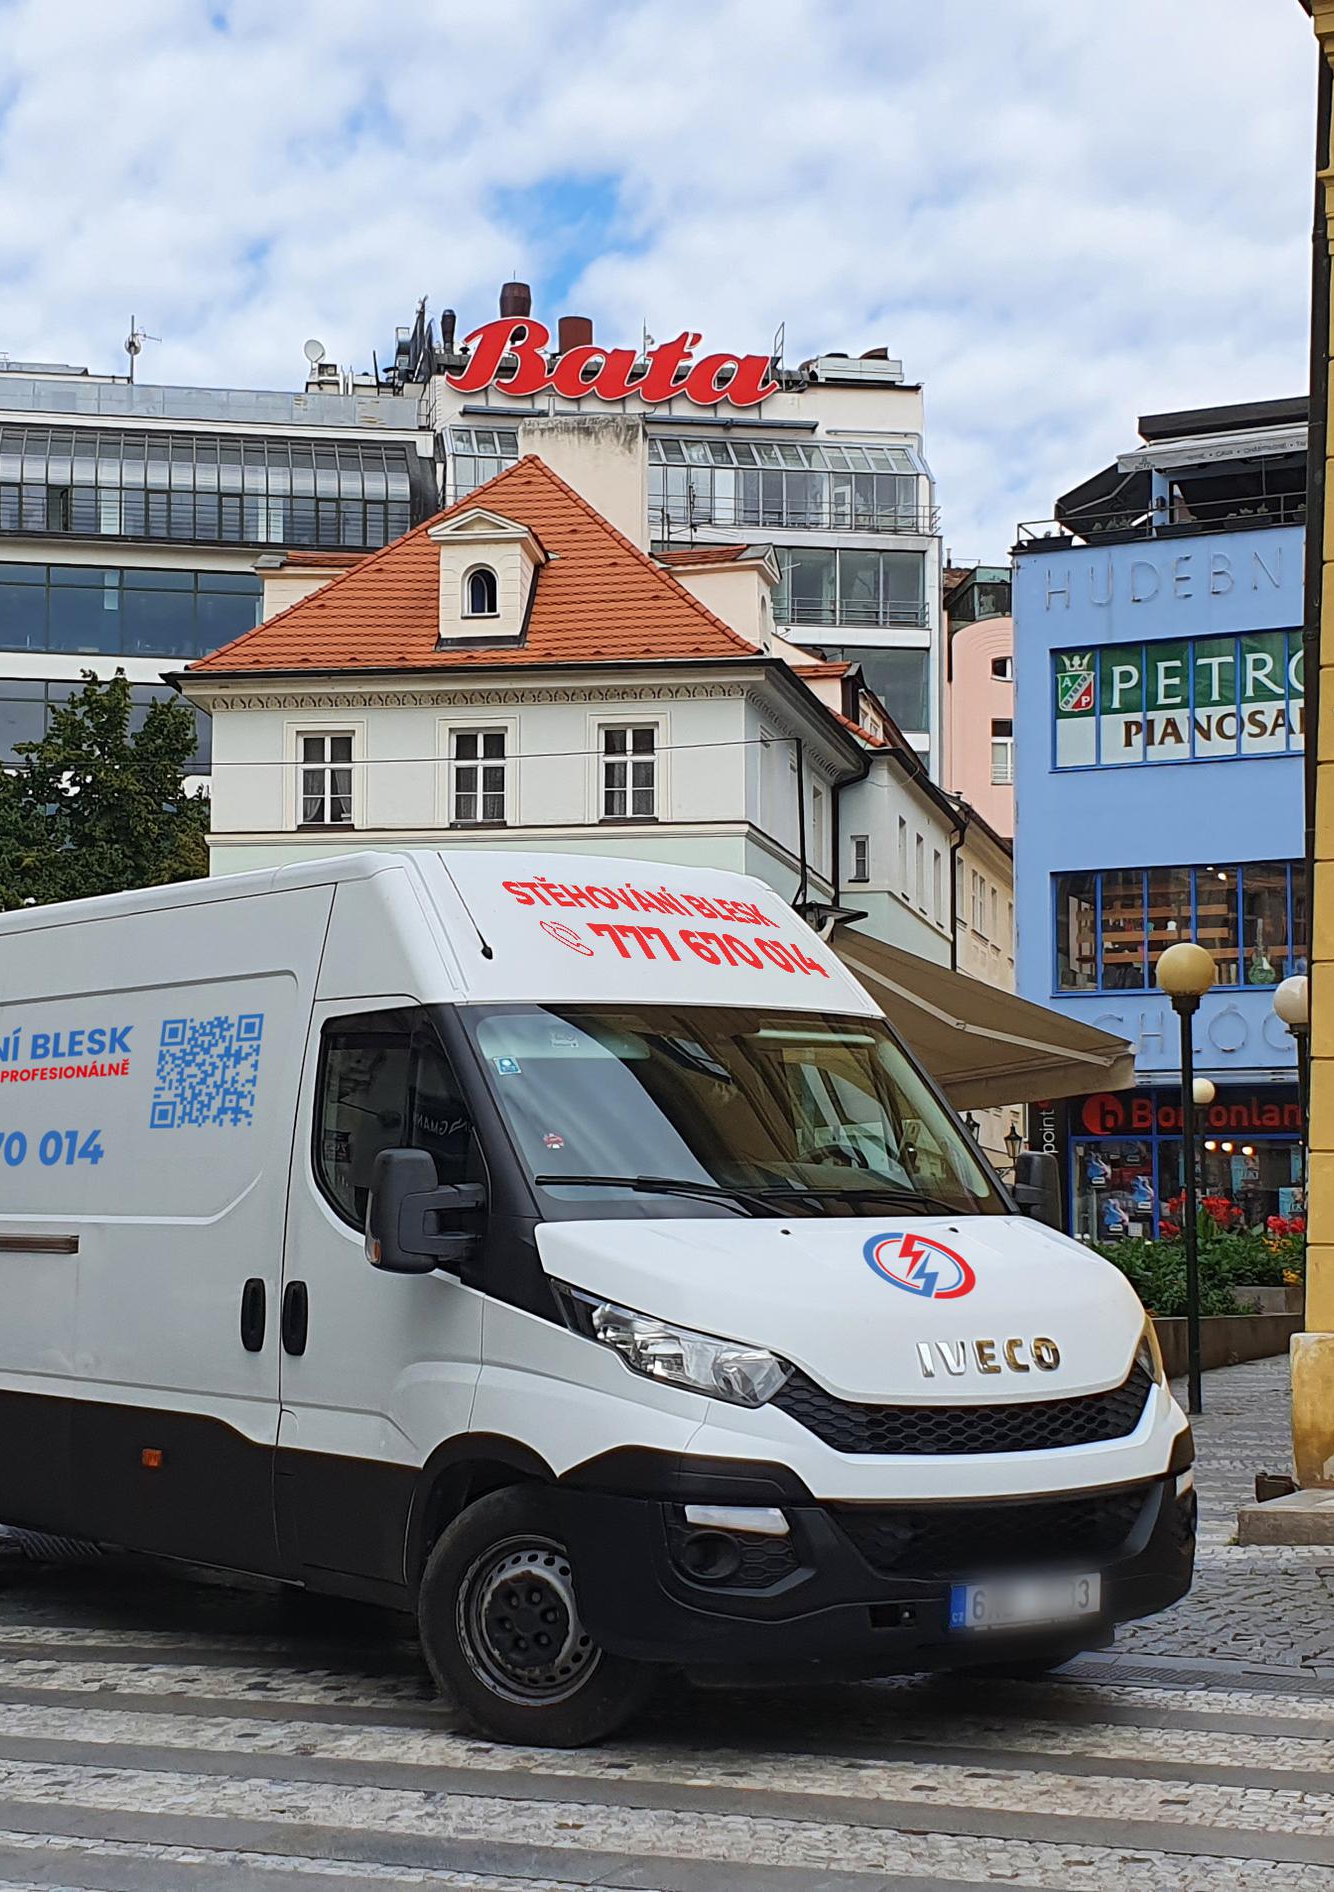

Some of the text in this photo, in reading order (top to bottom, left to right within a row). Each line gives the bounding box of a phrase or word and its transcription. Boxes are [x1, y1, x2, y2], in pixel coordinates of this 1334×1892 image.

[445, 316, 780, 407] Baťa
[501, 876, 781, 929] STĚHOVÁNÍ BLESK
[587, 922, 831, 979] 777 670 014
[30, 1025, 134, 1061] BLESK
[0, 1057, 130, 1083] PROFESIONÁLNĚ
[38, 1129, 105, 1167] 014
[1038, 1108, 1059, 1154] point
[915, 1336, 1061, 1378] IVECO
